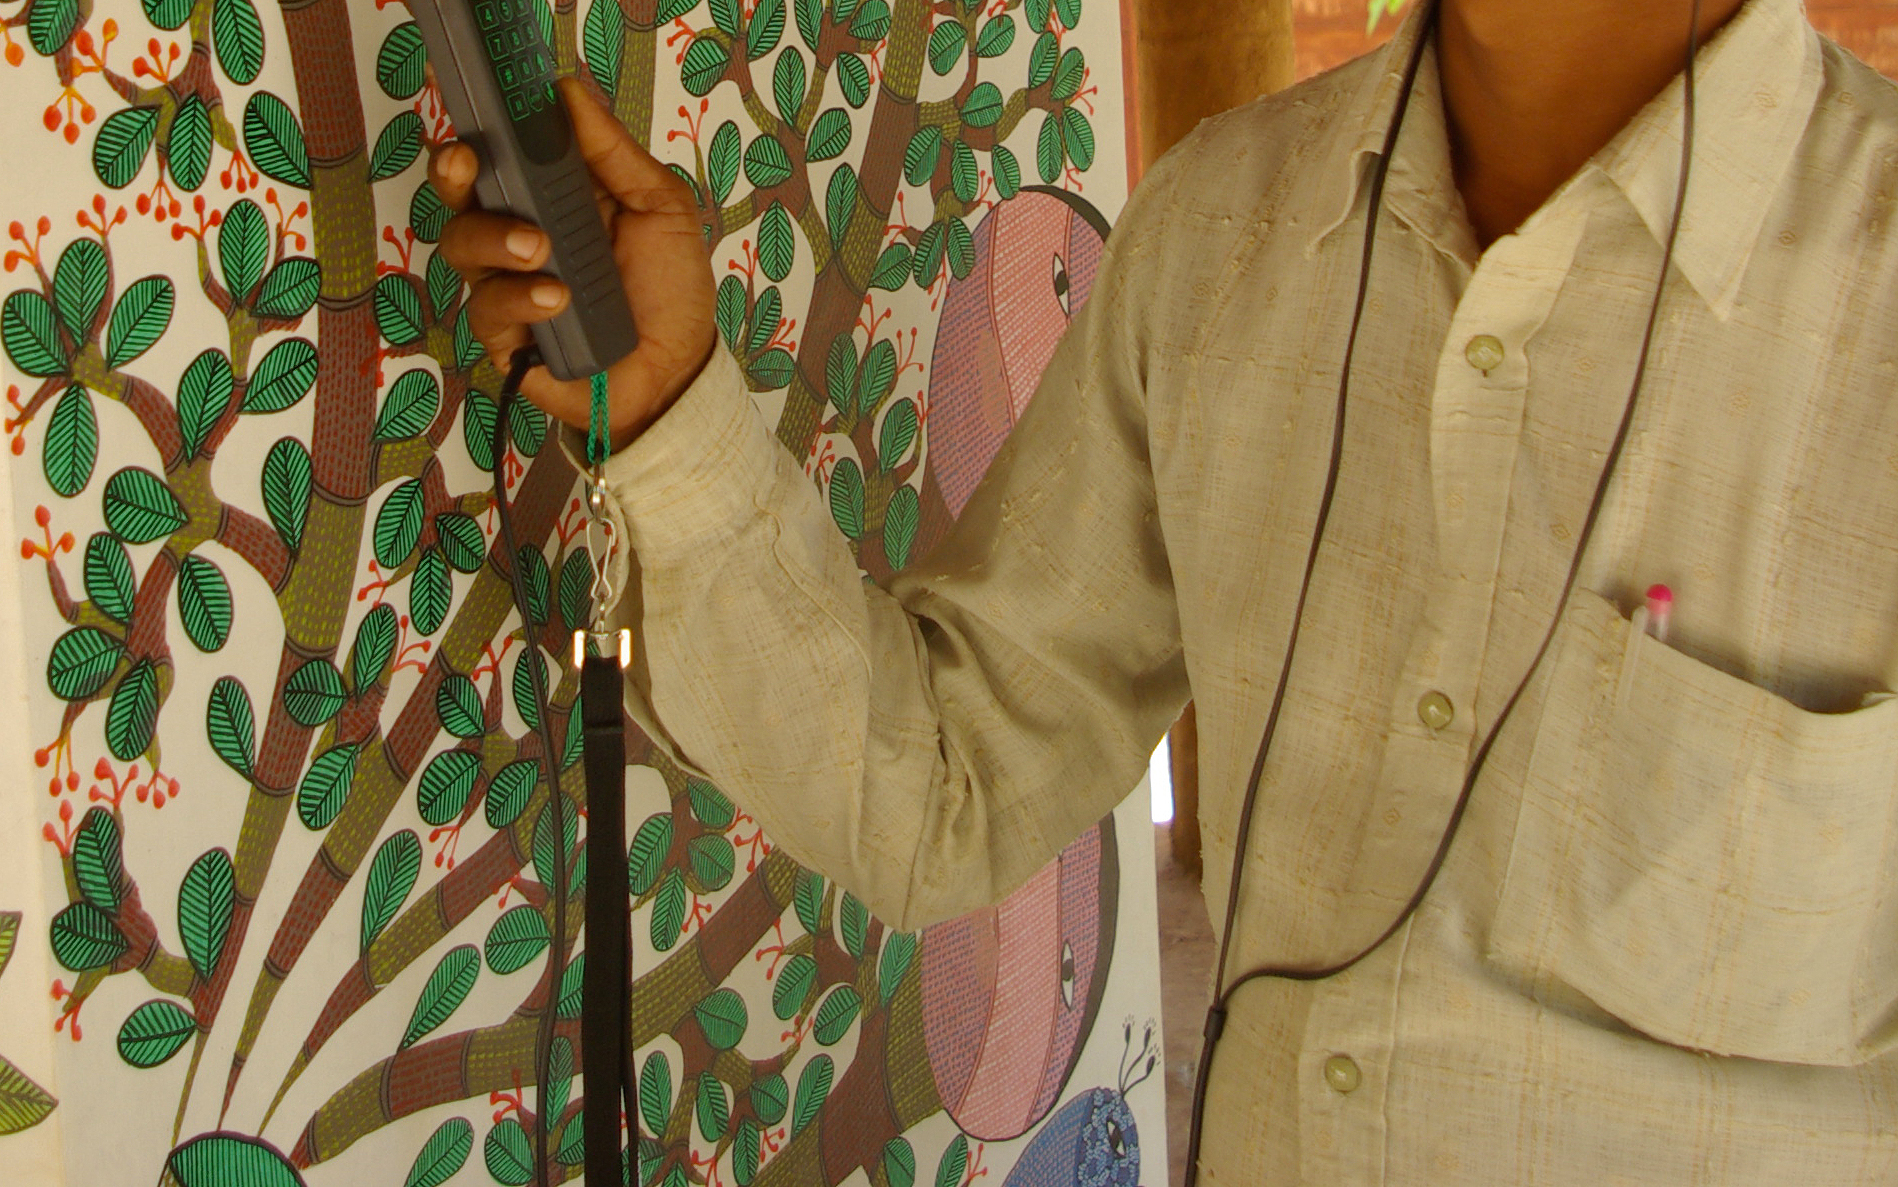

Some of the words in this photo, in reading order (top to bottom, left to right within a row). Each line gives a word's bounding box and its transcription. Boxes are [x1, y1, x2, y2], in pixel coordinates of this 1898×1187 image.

[484, 7, 493, 22] 4
[501, 0, 510, 16] 5
[493, 37, 502, 53] 7
